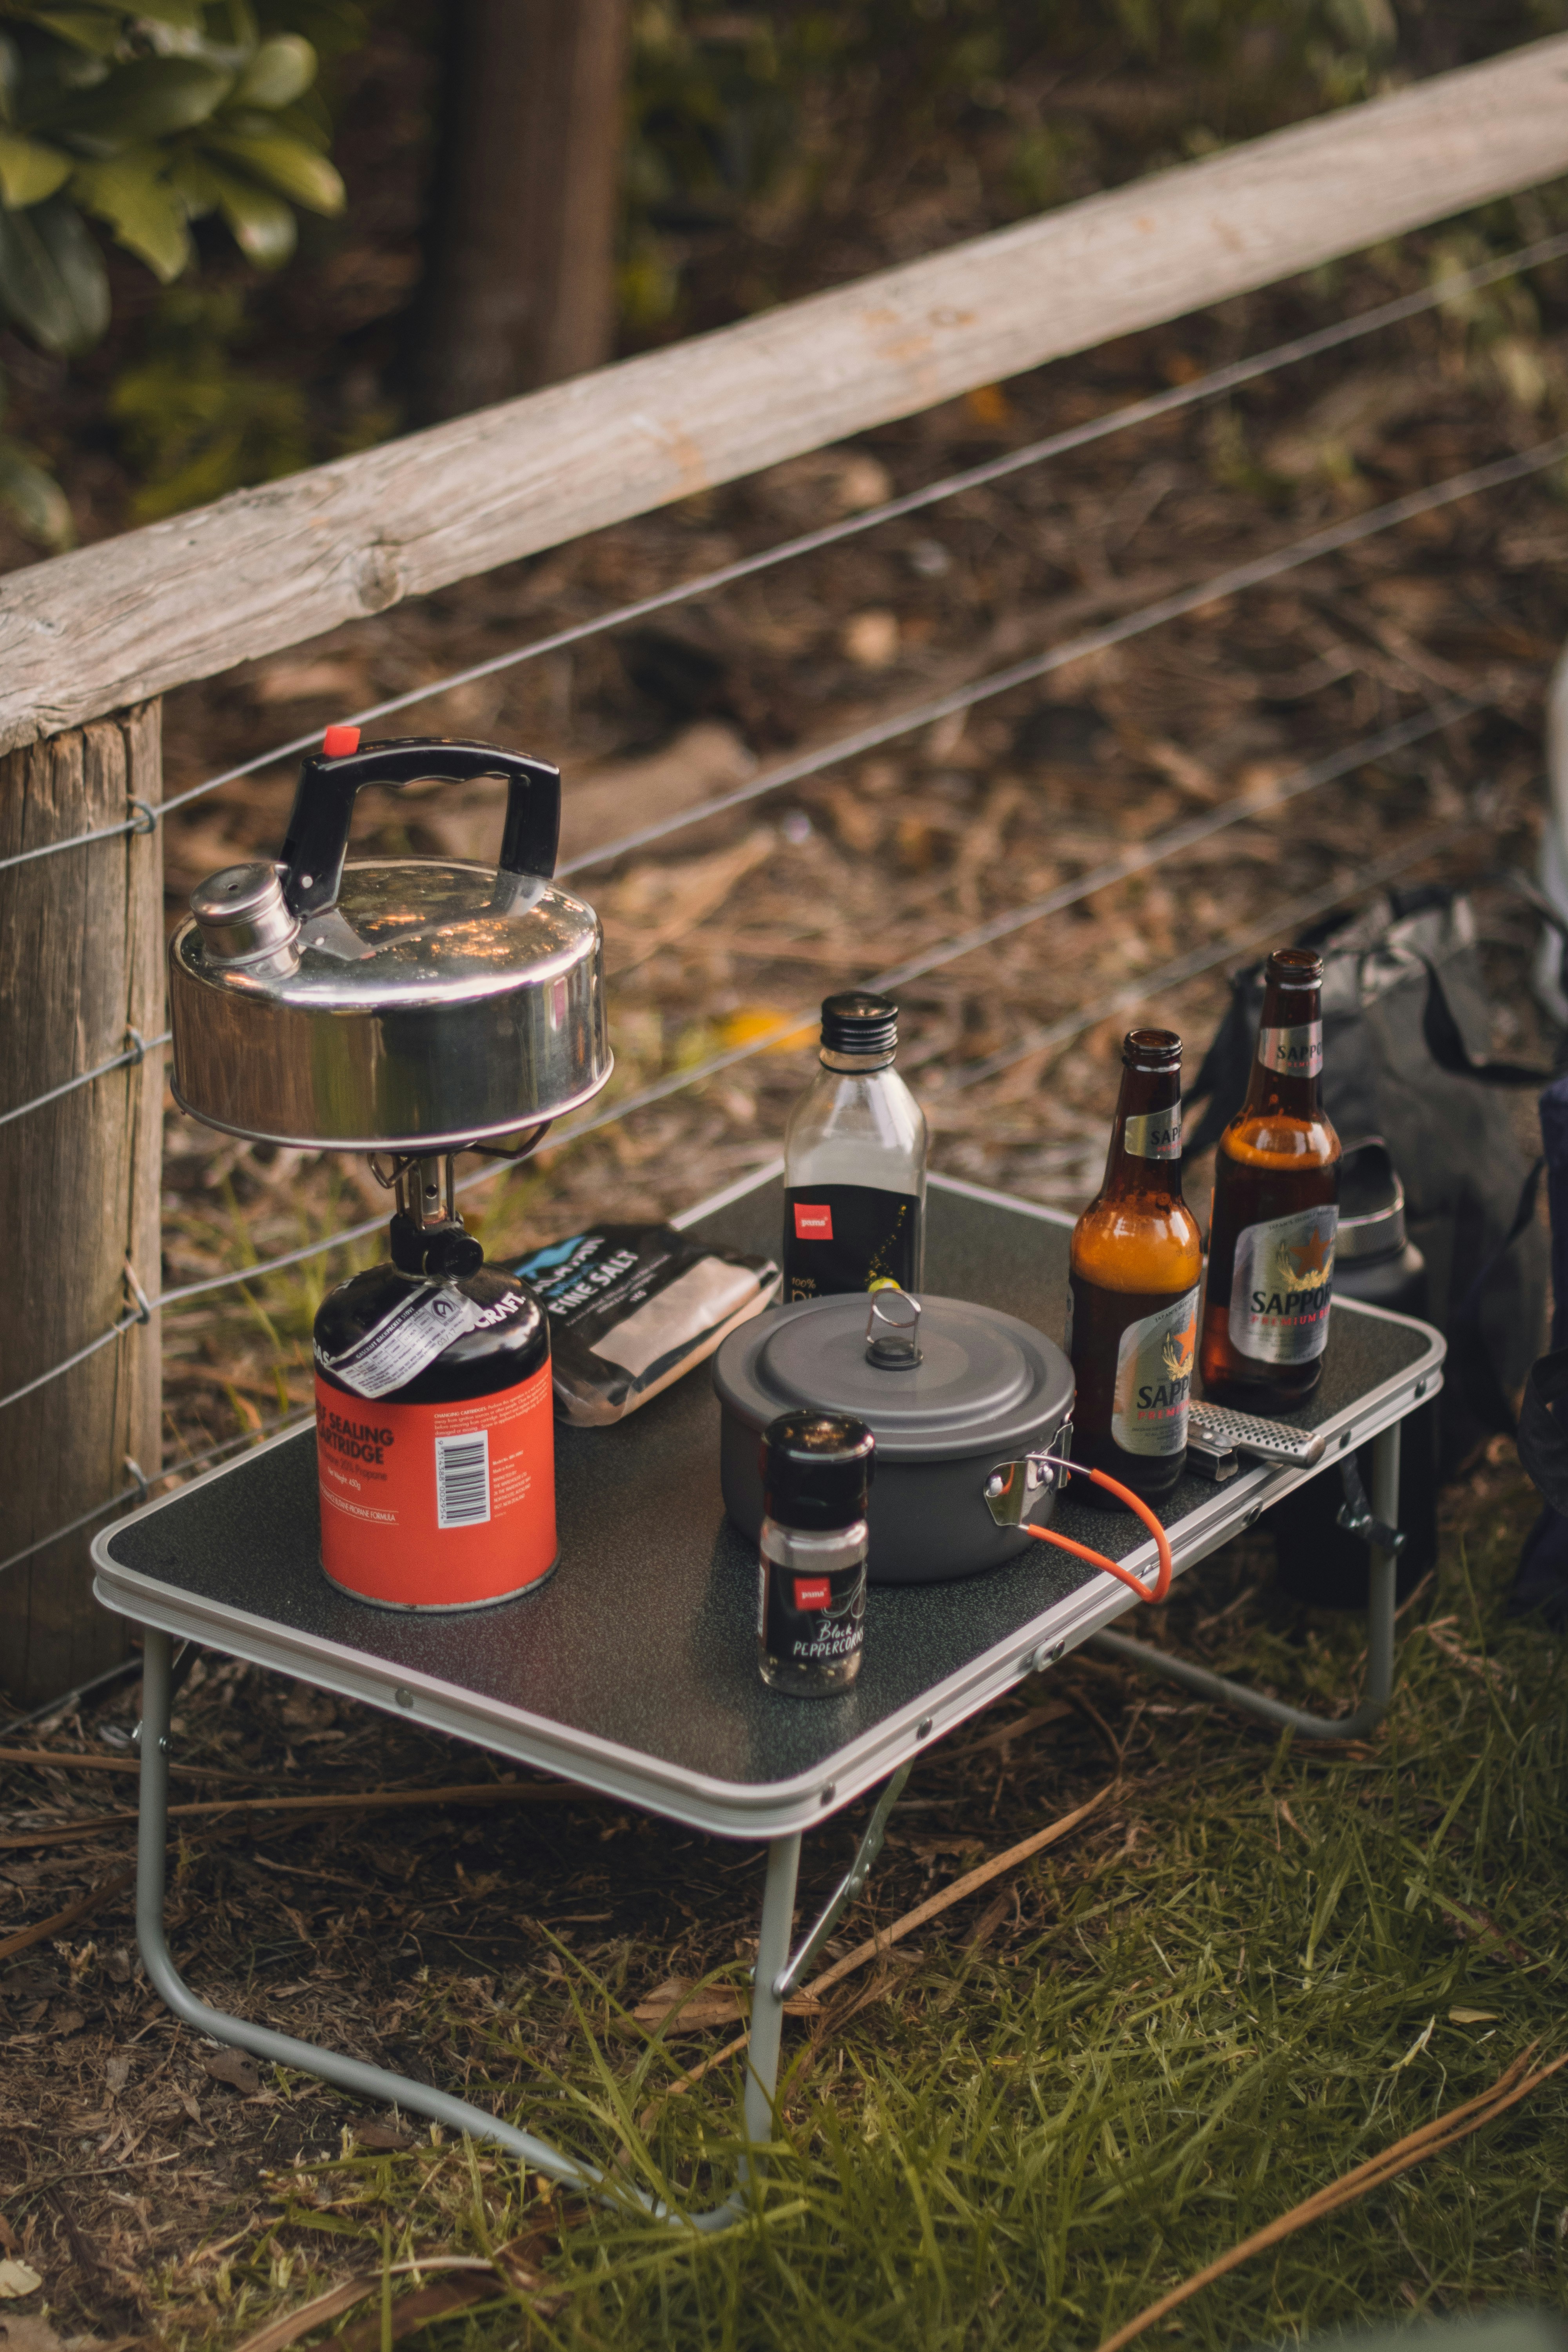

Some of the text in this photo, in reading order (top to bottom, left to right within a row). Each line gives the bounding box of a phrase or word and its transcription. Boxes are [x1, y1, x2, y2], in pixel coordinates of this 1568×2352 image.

[801, 1219, 826, 1227] pams
[548, 1282, 599, 1314] FINE
[589, 1250, 639, 1287] SALT
[792, 1277, 816, 1289] 100%
[466, 1292, 526, 1332] CRAFT.
[1251, 1312, 1316, 1326] PREMIUM
[356, 1341, 377, 1359] GASCRAFT
[376, 1317, 403, 1344] BACKPACKER
[401, 1307, 415, 1319] STOVE
[437, 1328, 456, 1346] 03/17
[329, 1412, 395, 1446] SEALING
[348, 1478, 361, 1491] 450g
[370, 1511, 396, 1522] FORMULA
[801, 1591, 825, 1600] pams
[816, 1619, 852, 1642] Black
